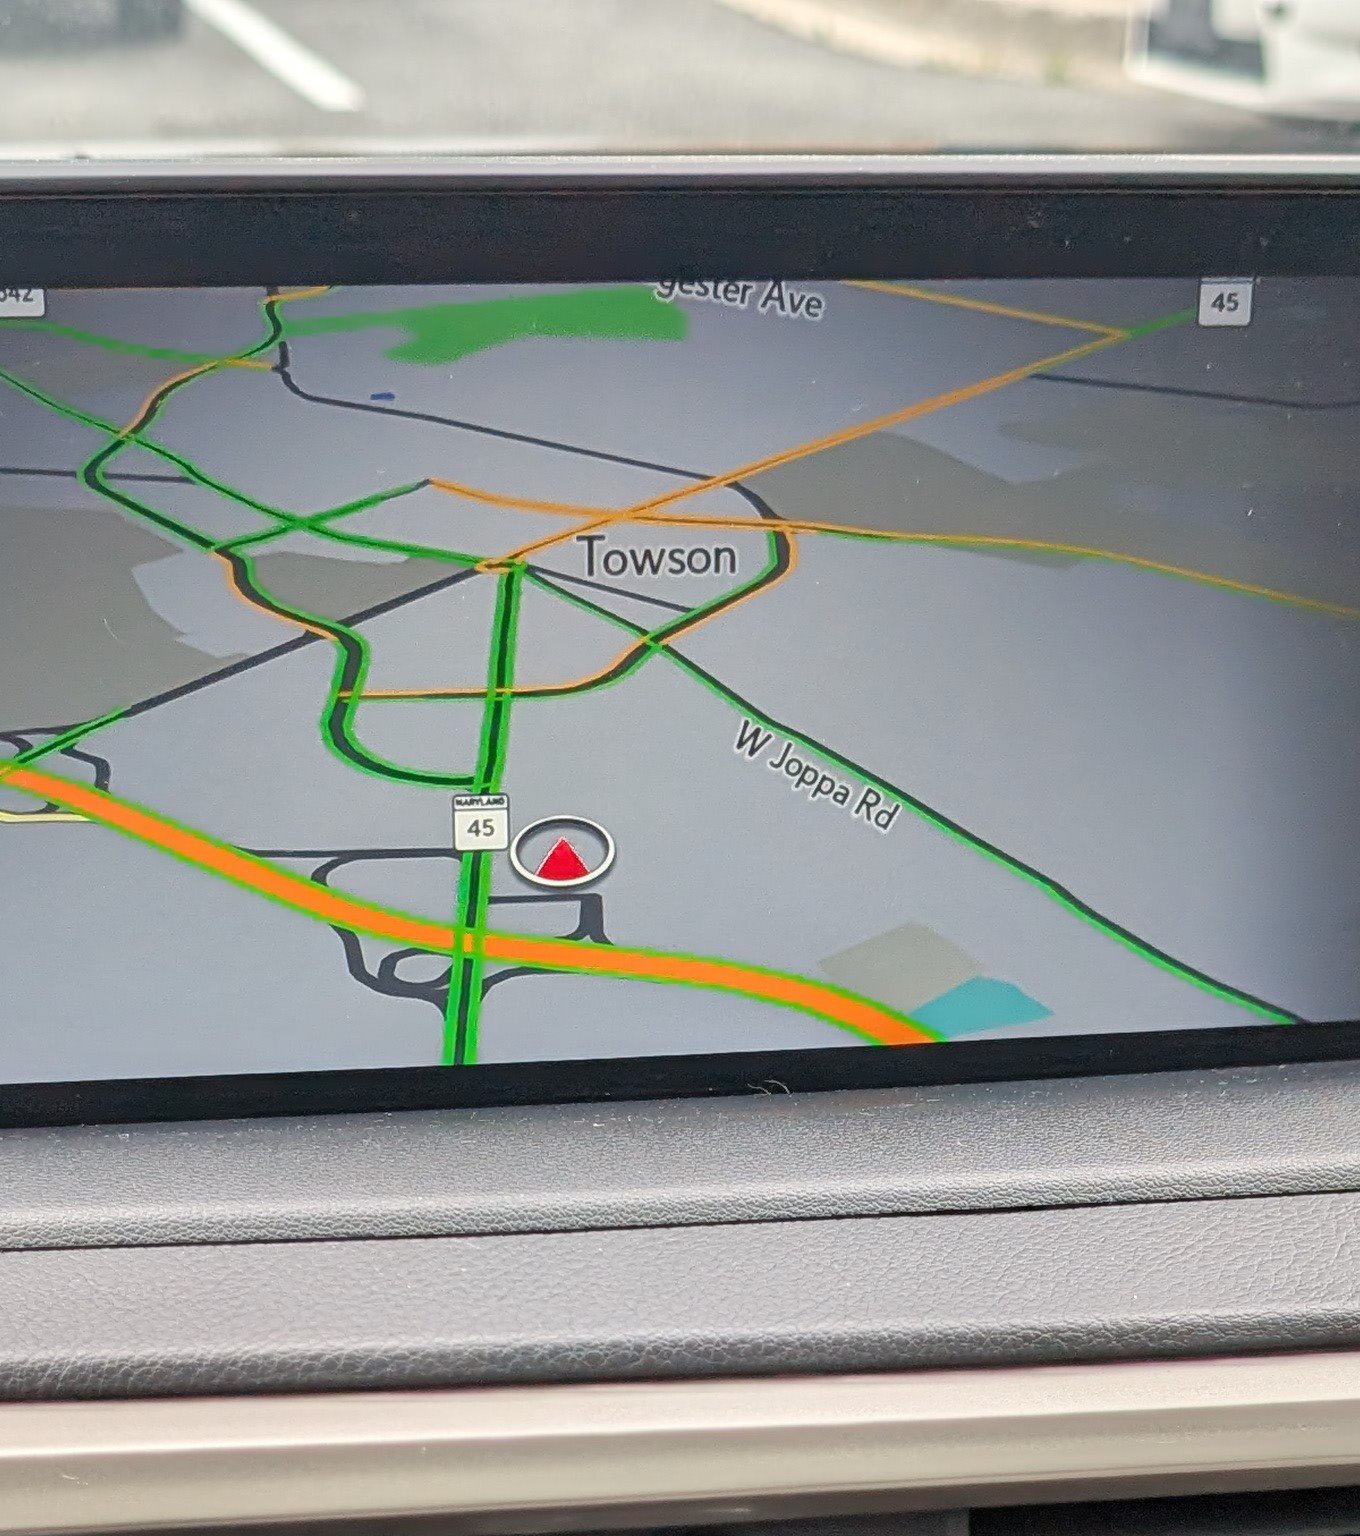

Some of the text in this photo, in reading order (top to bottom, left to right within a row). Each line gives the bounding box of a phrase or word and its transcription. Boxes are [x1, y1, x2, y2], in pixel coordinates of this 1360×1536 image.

[760, 281, 823, 318] Ave
[1211, 292, 1239, 313] 45
[577, 534, 738, 578] Towson
[736, 719, 901, 831] W Joppa Rd
[455, 796, 506, 807] MARYLAND
[466, 818, 496, 837] 45
